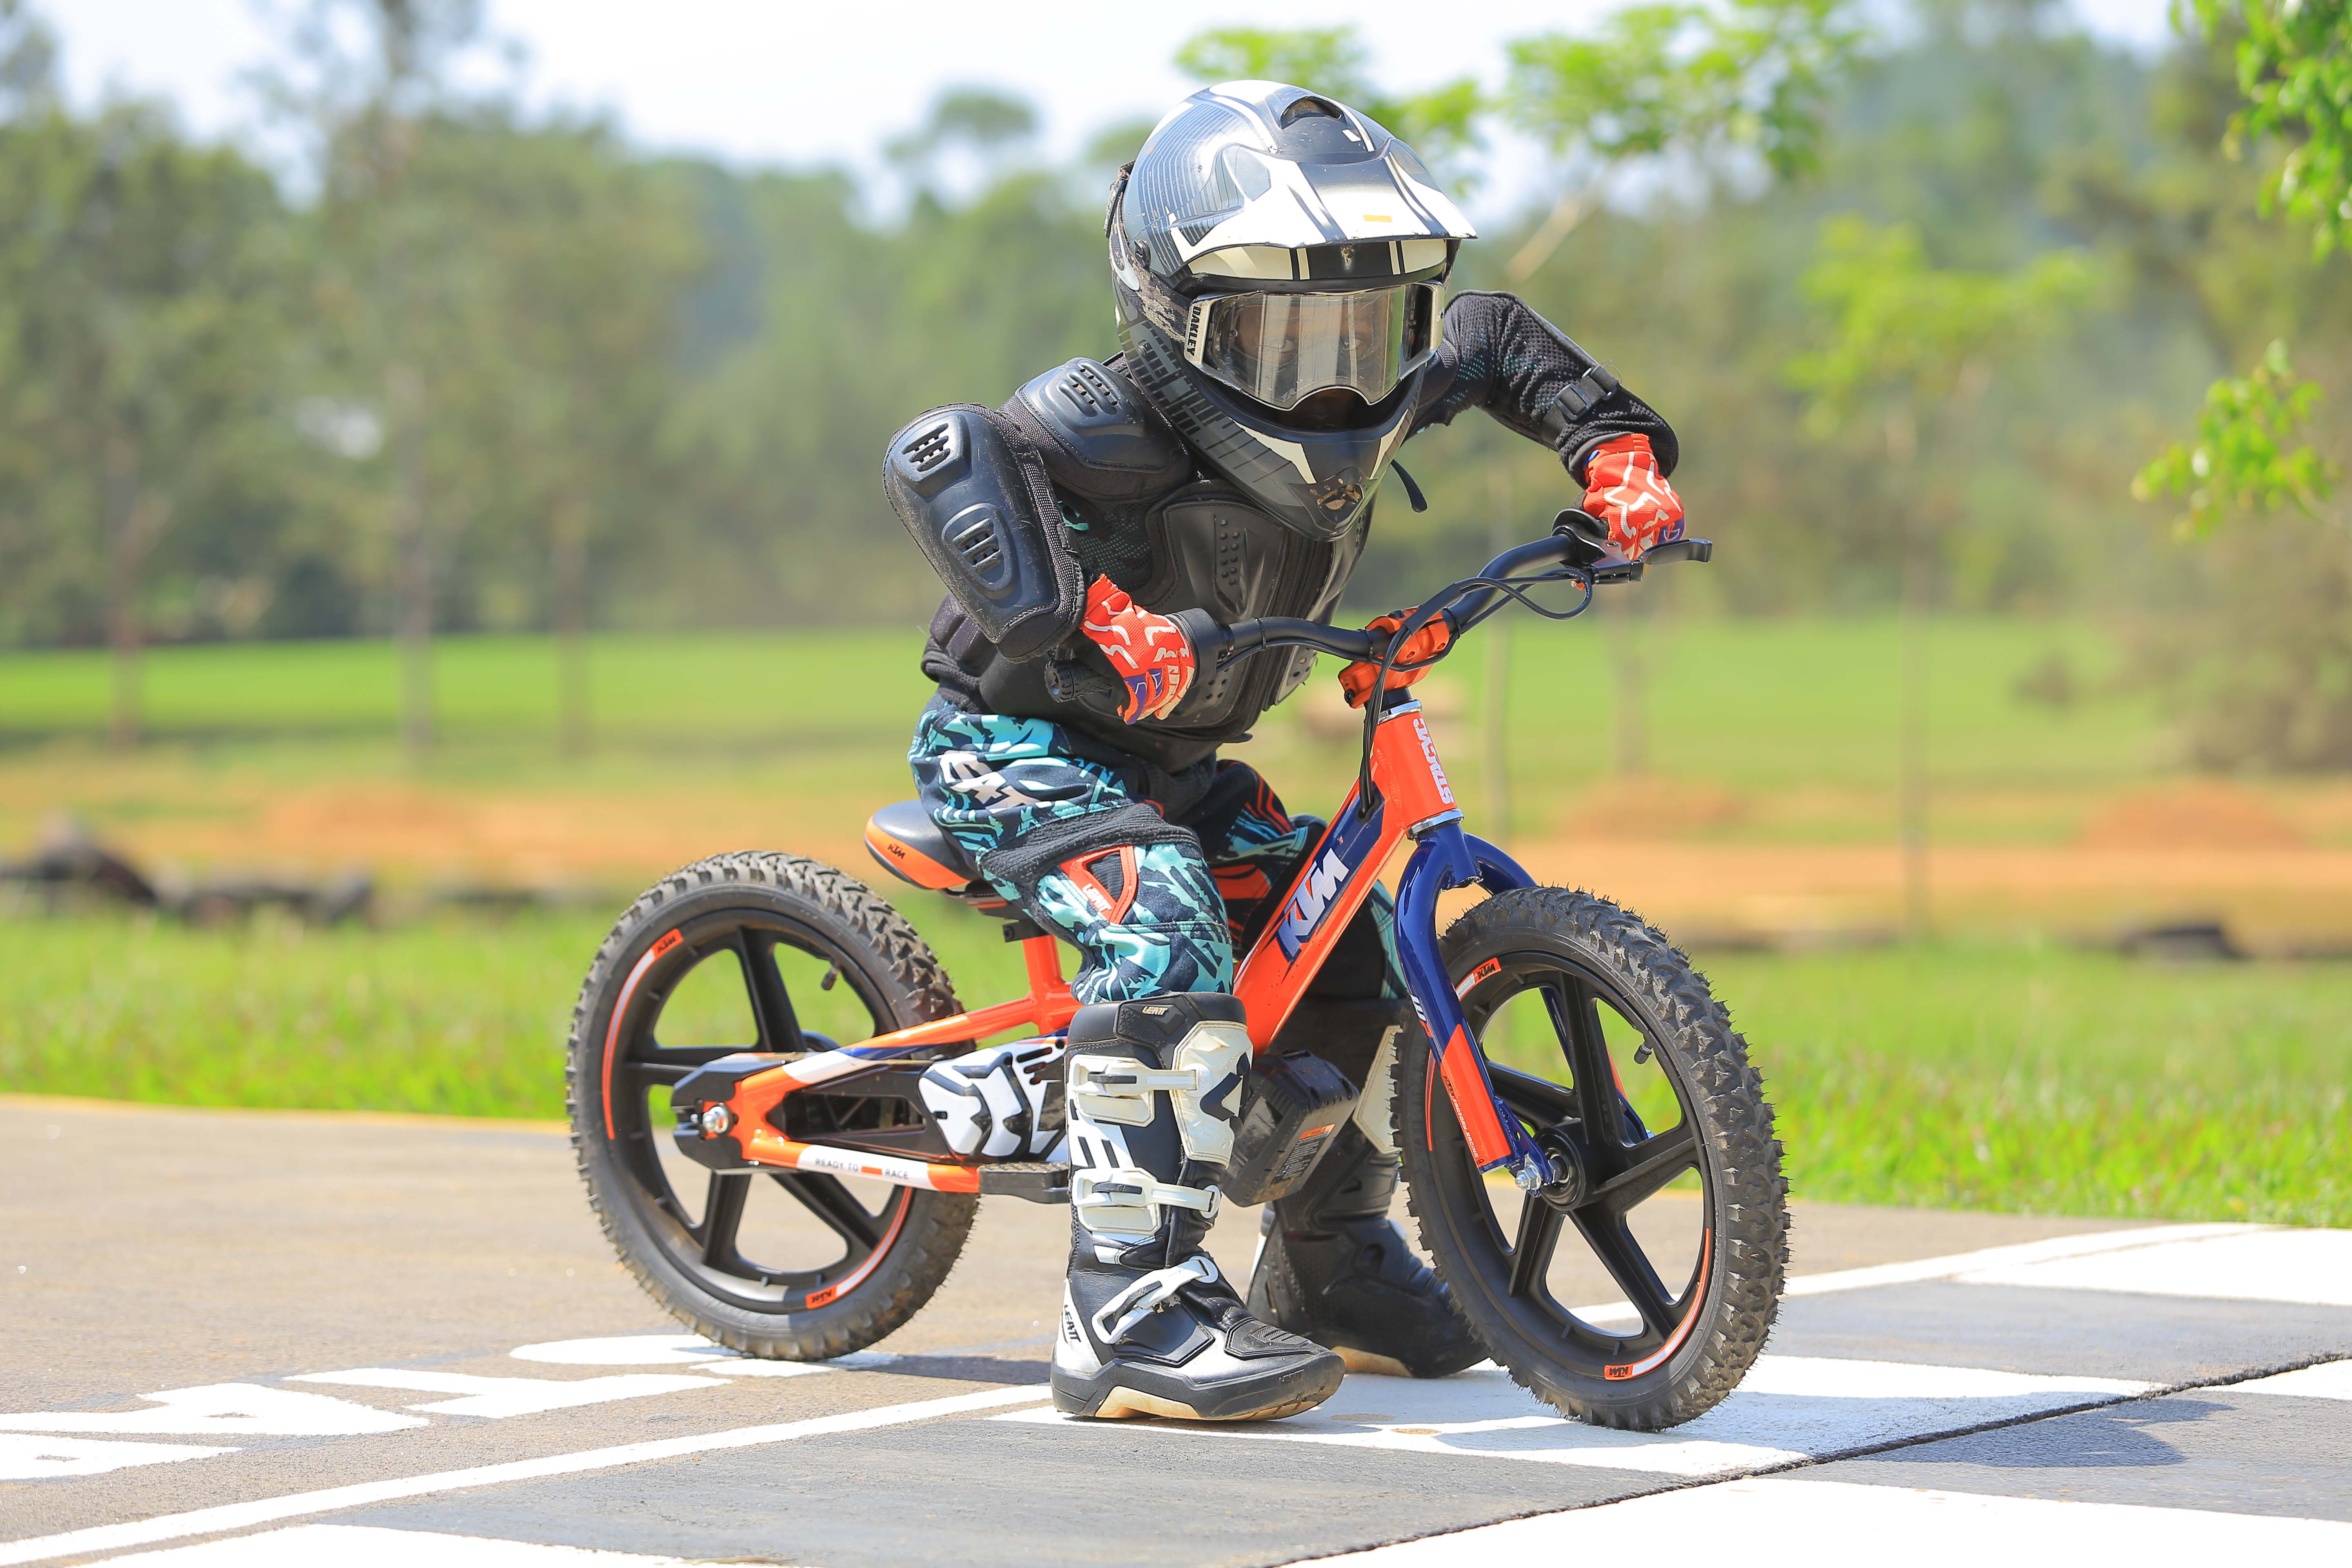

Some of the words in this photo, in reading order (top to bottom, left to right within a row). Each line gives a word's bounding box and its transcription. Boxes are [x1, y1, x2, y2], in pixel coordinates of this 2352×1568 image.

[1186, 306, 1201, 357] OAKLEY
[1412, 717, 1454, 804] STACYC
[887, 843, 905, 859] KTM
[1082, 883, 1112, 912] LEATT
[1277, 847, 1350, 958] KTM
[1477, 962, 1497, 980] KTM
[1142, 1006, 1168, 1016] LEATT
[1452, 1098, 1468, 1130] FACTORY
[815, 1158, 843, 1170] READY
[848, 1163, 859, 1172] TO
[884, 1168, 909, 1180] RACE
[1609, 1366, 1629, 1378] KTM
